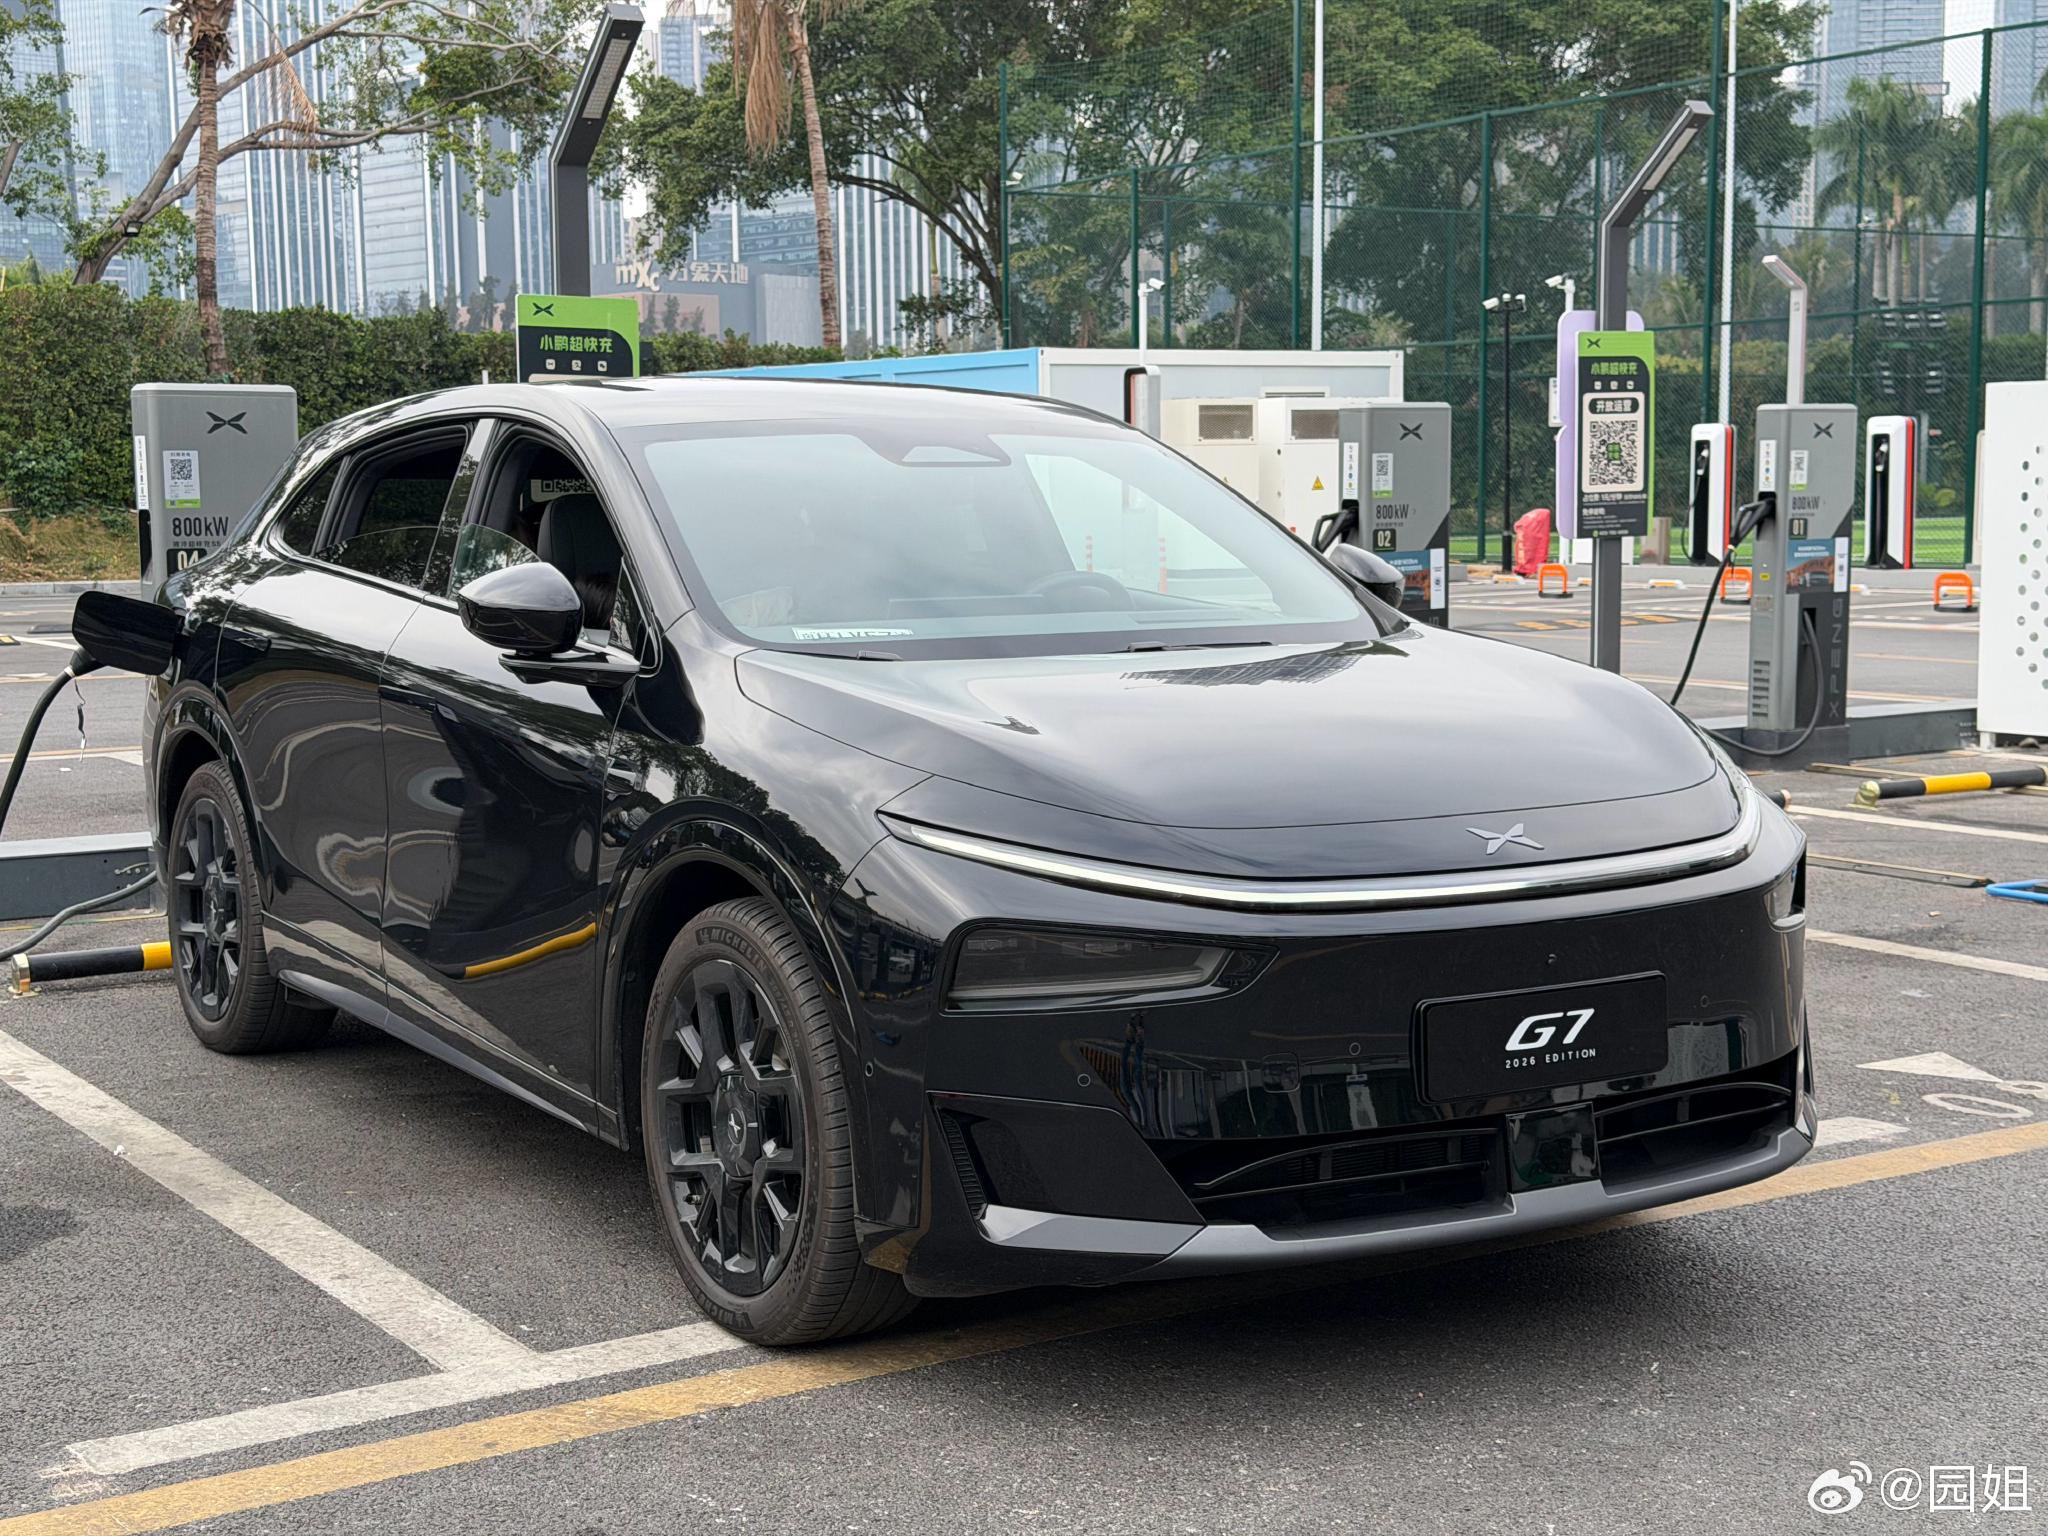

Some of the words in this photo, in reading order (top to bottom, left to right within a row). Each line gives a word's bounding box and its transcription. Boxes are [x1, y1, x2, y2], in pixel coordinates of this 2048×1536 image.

[667, 260, 749, 285] 万象天地
[540, 334, 613, 353] 小鹏超快充
[1590, 362, 1638, 375] 小鹏超快充
[1595, 399, 1632, 413] 开放运营
[1376, 504, 1409, 519] 800kW
[172, 516, 228, 537] 800kW
[1792, 519, 1804, 535] 01
[1377, 530, 1392, 547] 02
[177, 550, 199, 570] 04
[1829, 598, 1843, 718] XPENG
[710, 928, 768, 973] MICHELIN
[1505, 1008, 1595, 1051] G7
[1505, 1056, 1536, 1069] 2026
[1545, 1048, 1596, 1064] EDITION
